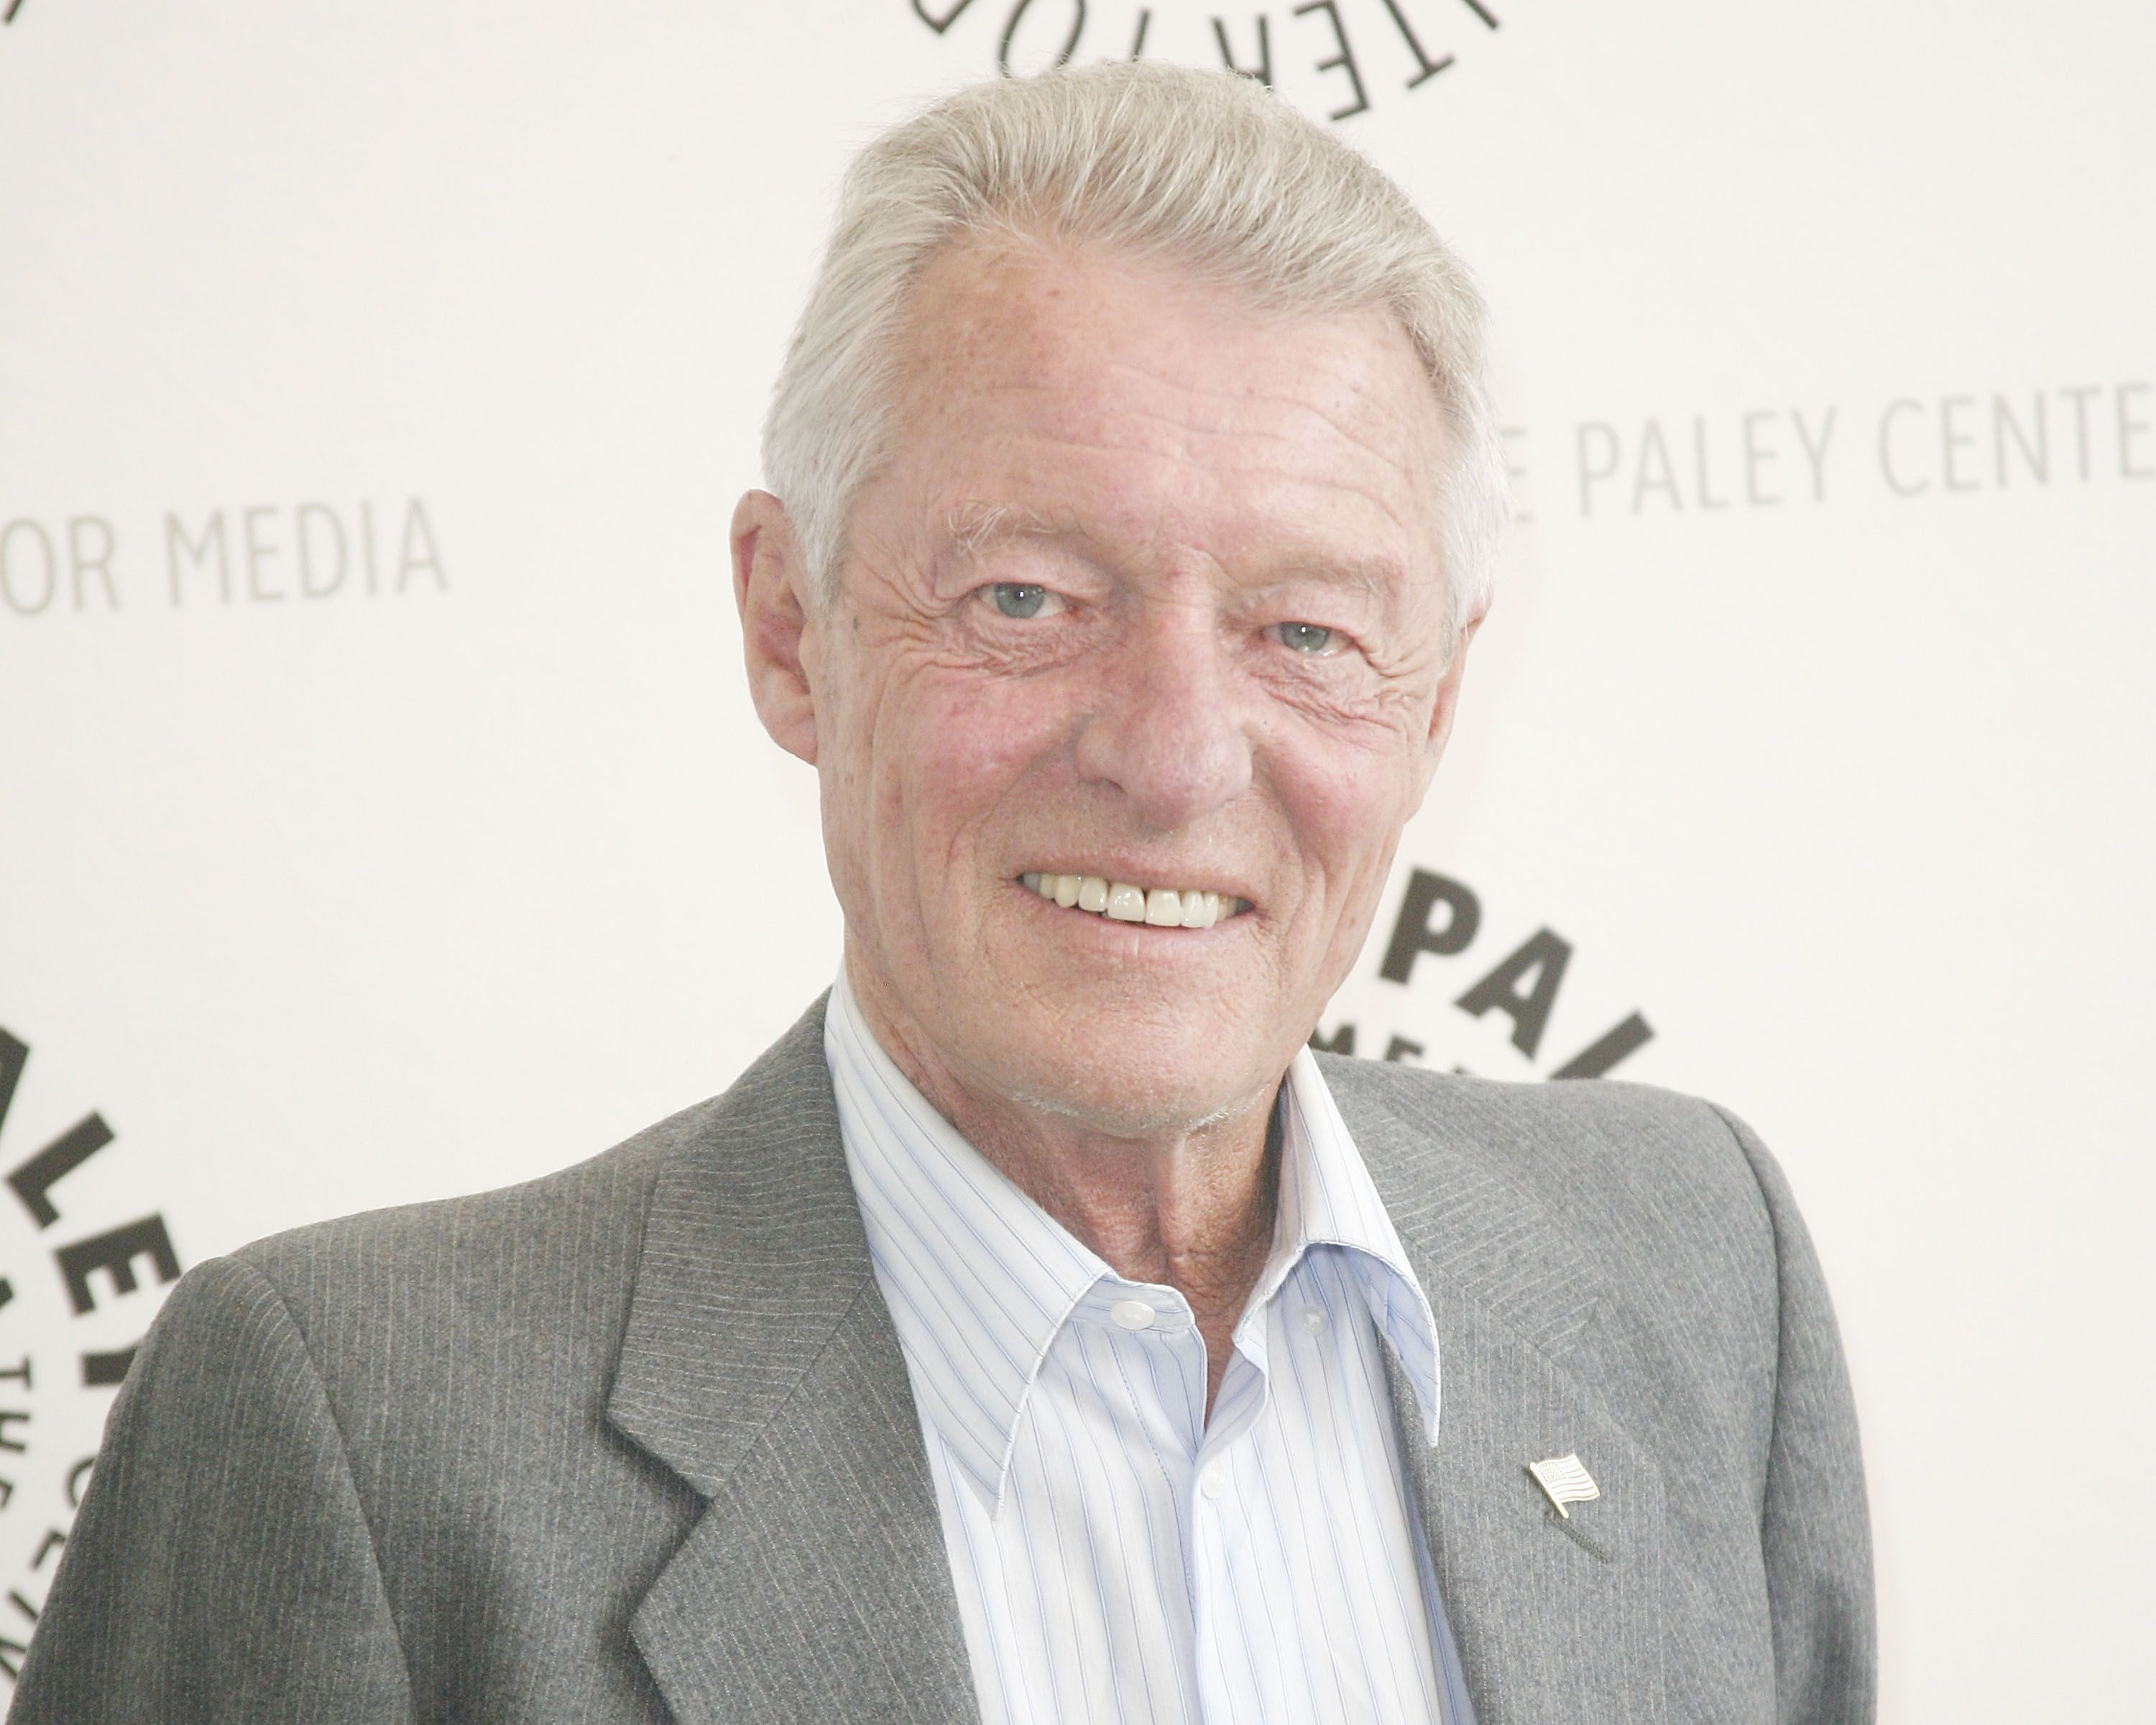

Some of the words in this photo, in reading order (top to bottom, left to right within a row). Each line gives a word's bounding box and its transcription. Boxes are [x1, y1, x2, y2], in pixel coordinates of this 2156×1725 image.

[1575, 404, 1838, 518] PALEY
[1876, 382, 2156, 497] CENTE
[165, 497, 451, 607] MEDIA
